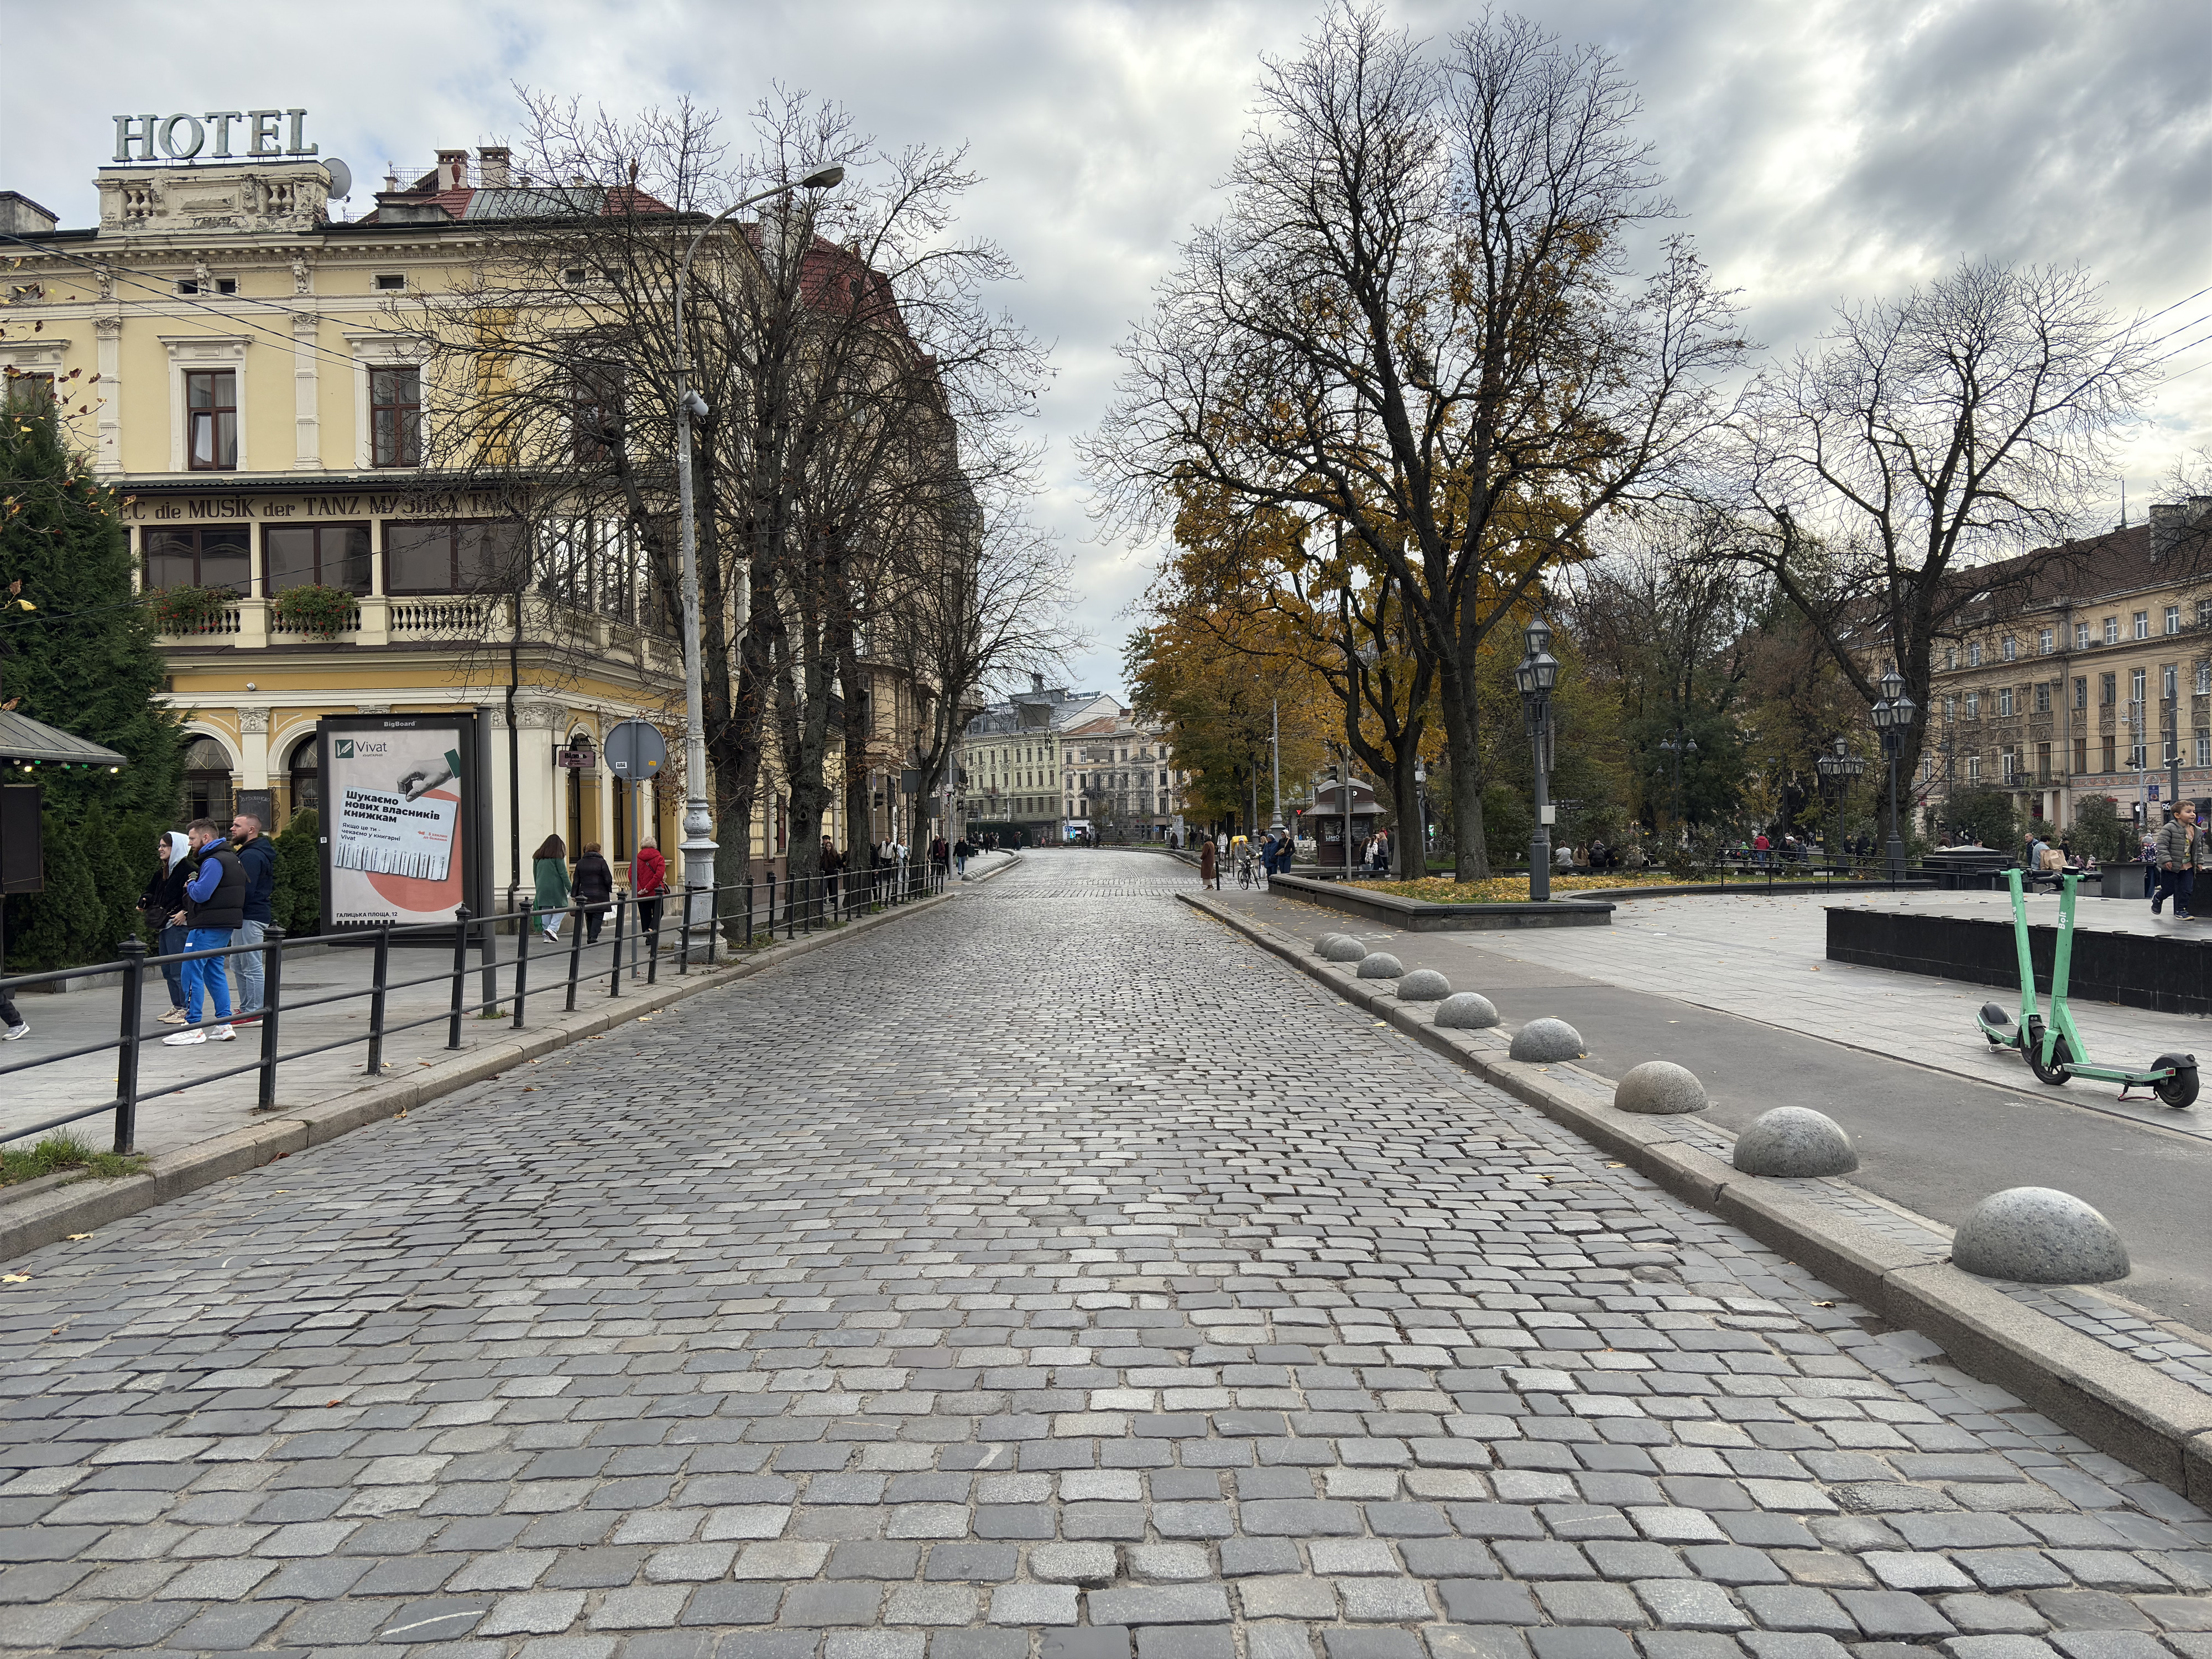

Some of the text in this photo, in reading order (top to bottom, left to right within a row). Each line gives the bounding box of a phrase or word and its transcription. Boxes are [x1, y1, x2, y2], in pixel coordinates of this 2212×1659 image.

[112, 108, 319, 162] HOTEL
[118, 501, 145, 520] EC
[155, 502, 181, 519] die
[189, 498, 255, 518] MUSIK
[263, 501, 295, 517] der
[304, 496, 360, 515] TANZ
[356, 741, 387, 752] Vivat
[346, 790, 399, 805] Шукаємо
[343, 809, 397, 823] книжкам
[345, 801, 440, 820] нових власників
[2058, 911, 2068, 930] Bolt
